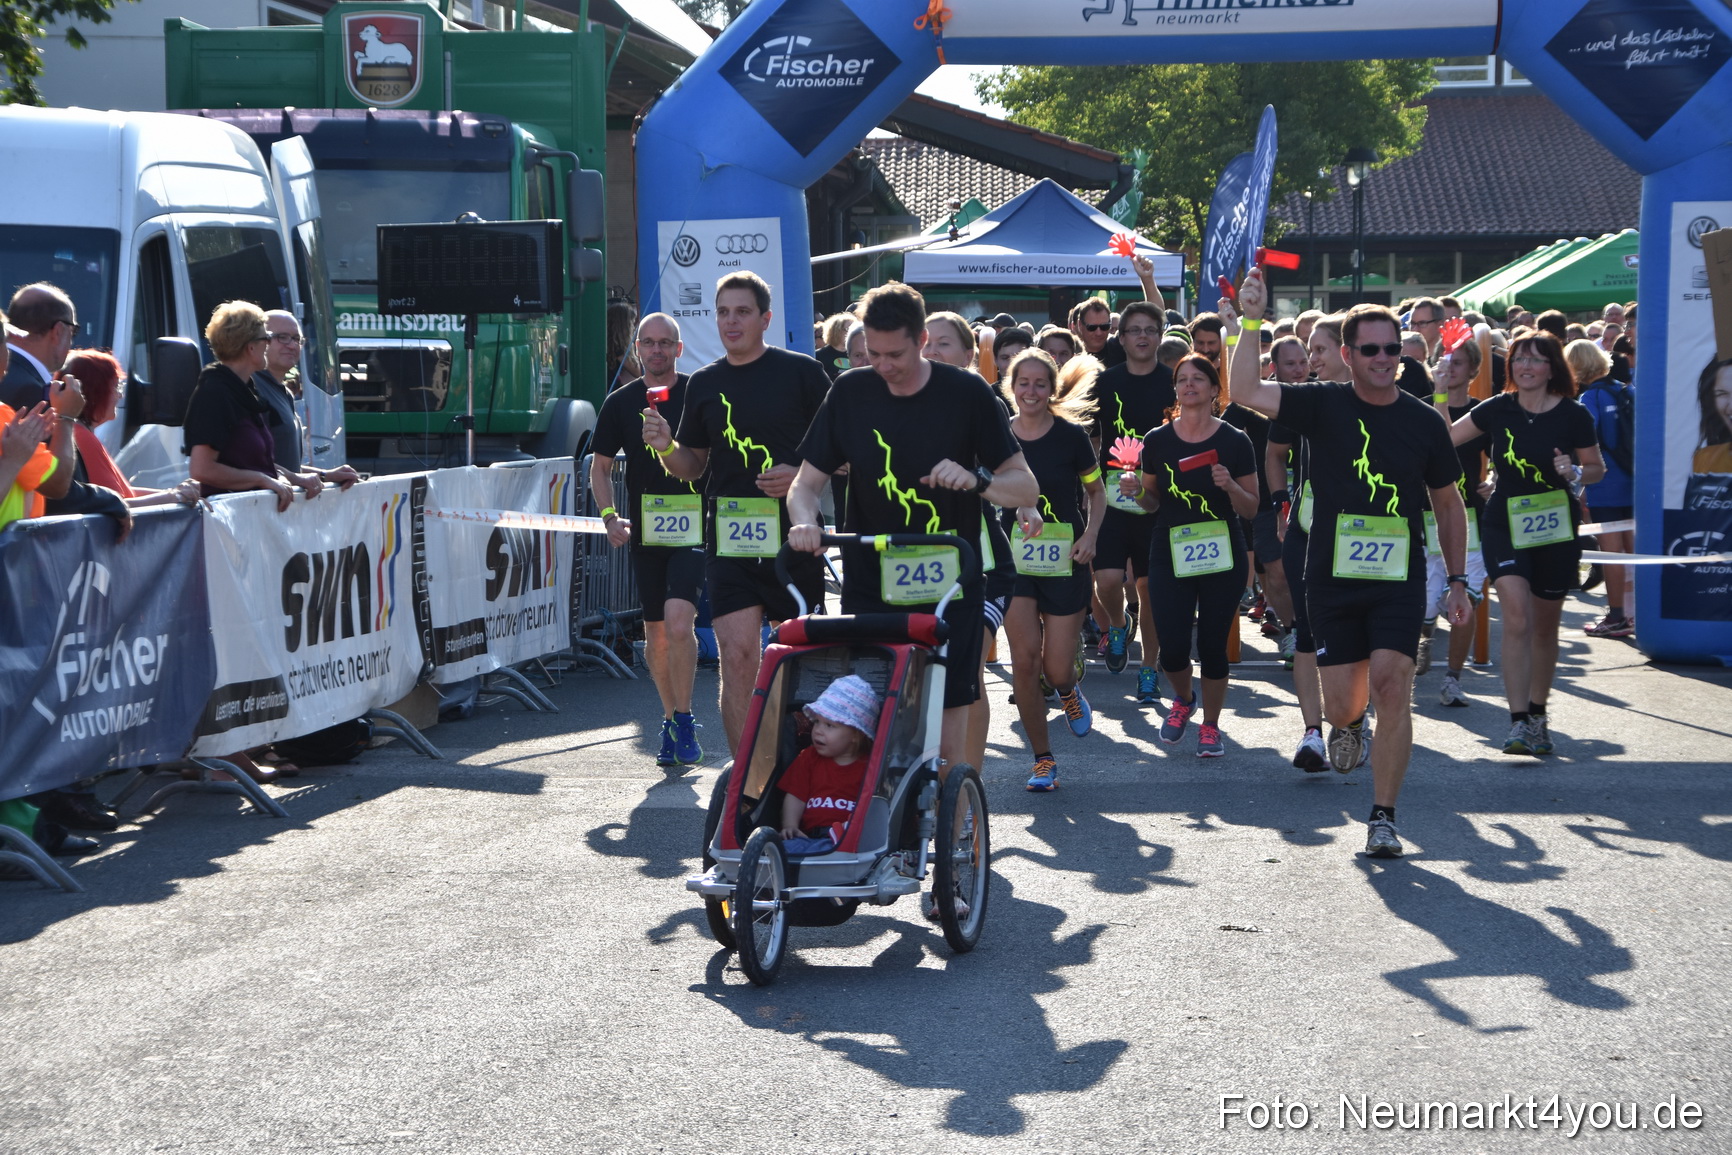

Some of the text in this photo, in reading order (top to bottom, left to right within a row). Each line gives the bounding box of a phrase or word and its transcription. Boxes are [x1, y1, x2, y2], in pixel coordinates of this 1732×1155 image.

[1156, 11, 1241, 25] neumarkt
[1586, 35, 1617, 51] und
[1620, 31, 1650, 45] das
[766, 54, 874, 75] Fischer
[368, 84, 400, 96] 1628
[776, 77, 865, 88] AUTOMOBILE
[718, 259, 741, 267] Audi
[958, 263, 1127, 276] www.fischer-automobile.de
[654, 516, 690, 532] 220
[729, 522, 767, 541] 245
[1522, 512, 1559, 533] 225
[1022, 544, 1060, 562] 218
[1183, 542, 1220, 562] 223
[1349, 541, 1395, 562] 227
[895, 561, 945, 586] 243
[282, 541, 371, 652] swn
[60, 698, 154, 742] AUTOMOBILE
